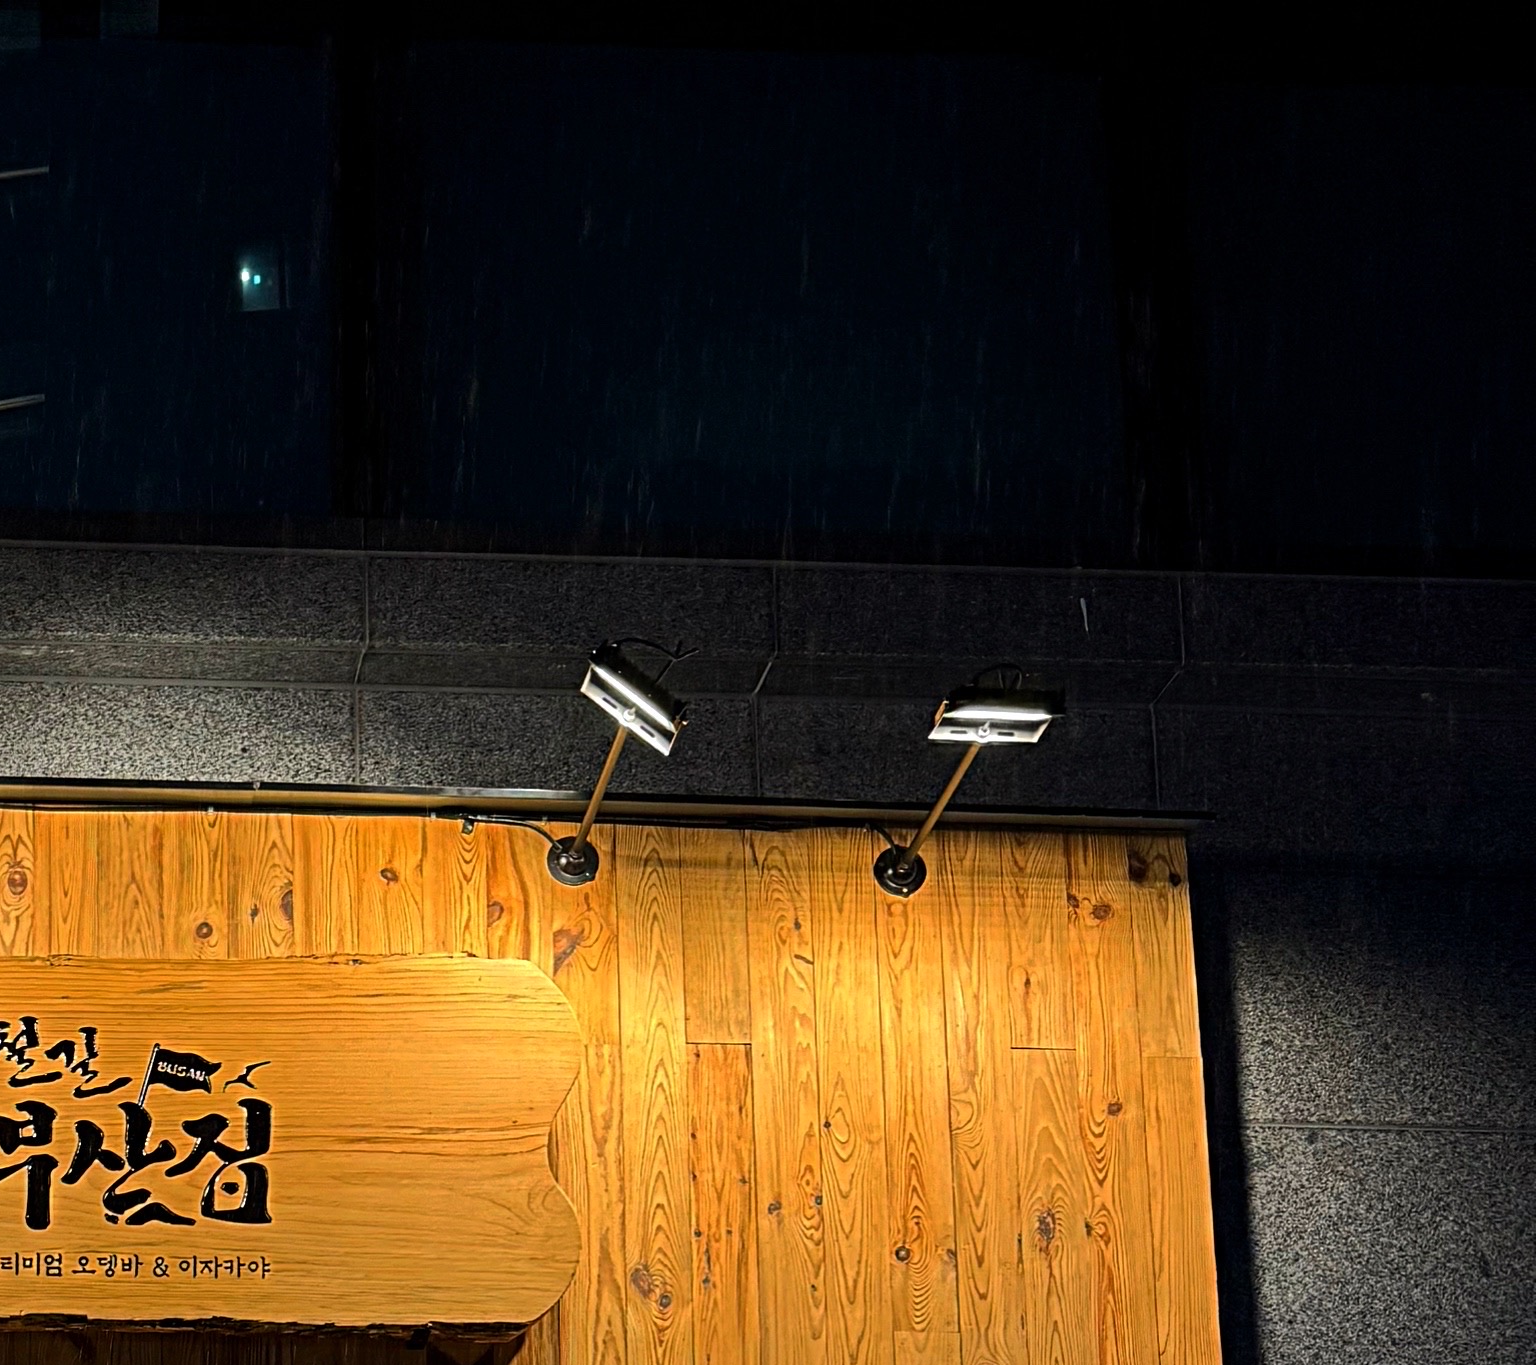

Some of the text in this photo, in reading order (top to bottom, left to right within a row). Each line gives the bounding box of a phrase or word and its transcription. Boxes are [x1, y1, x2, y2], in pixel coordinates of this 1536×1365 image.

[157, 1060, 206, 1083] BUSAN
[72, 1252, 144, 1279] 오뎅바
[153, 1257, 171, 1279] &
[179, 1254, 272, 1280] 이자카야
